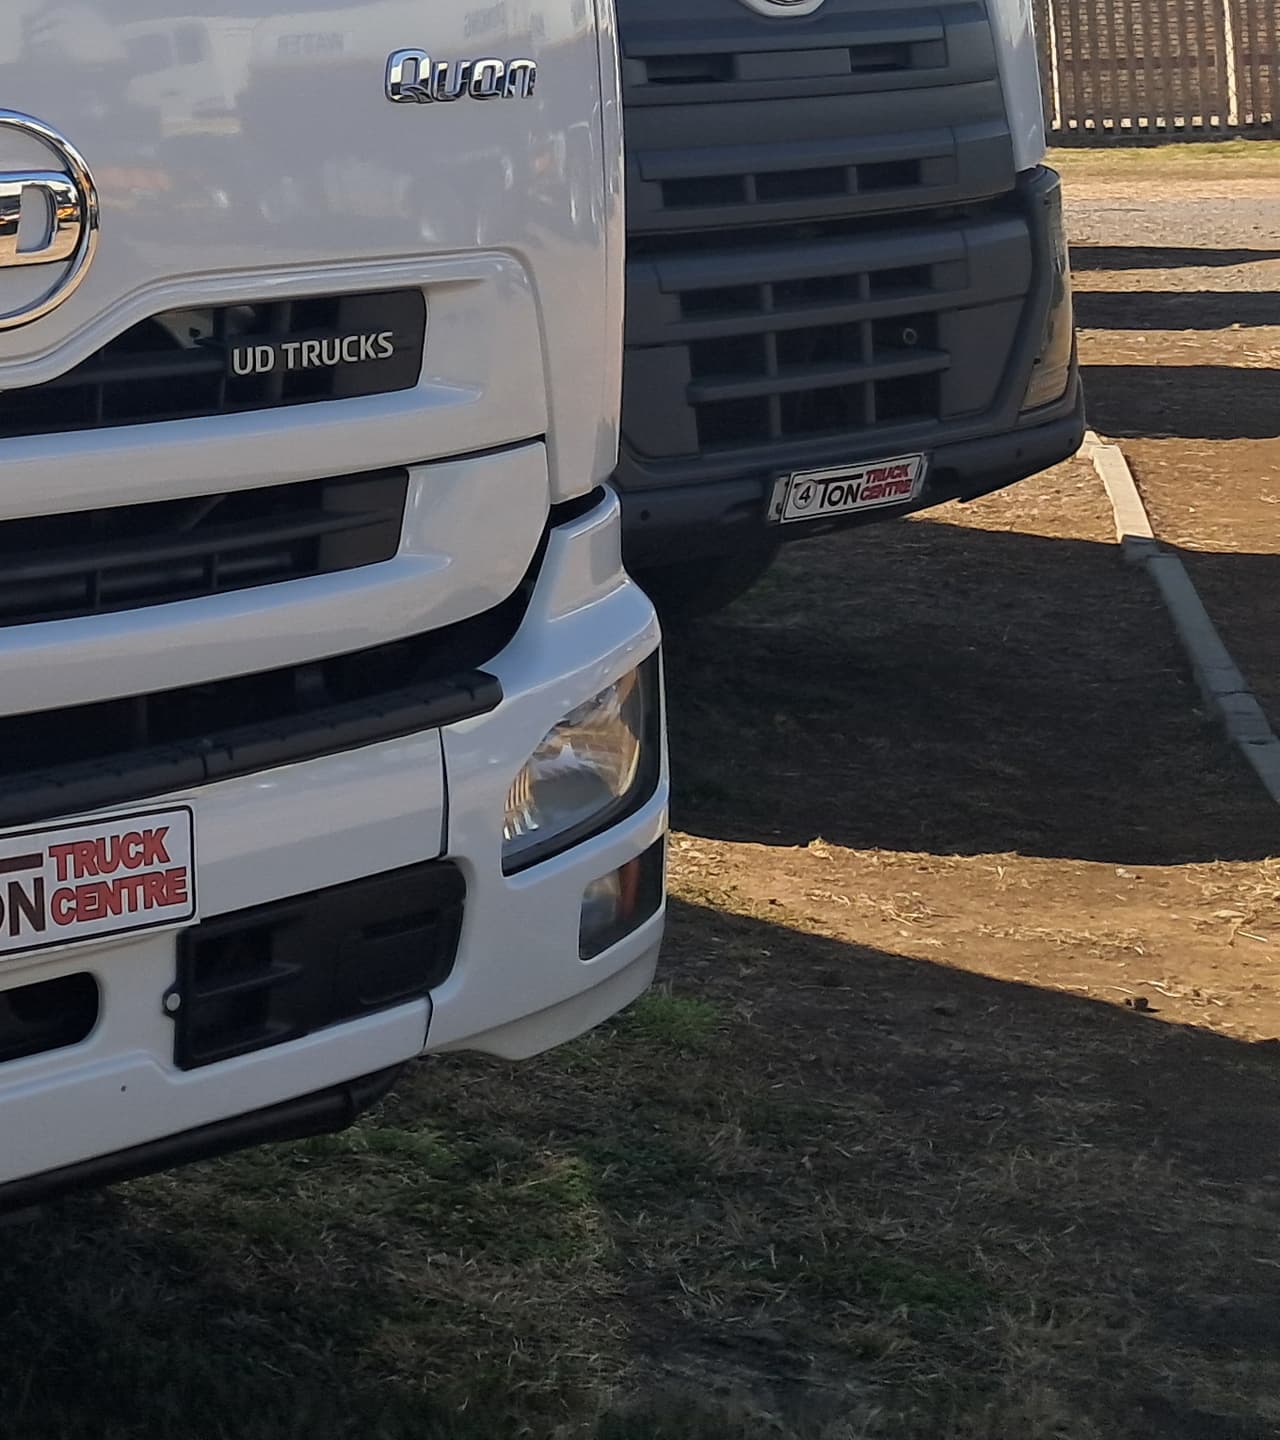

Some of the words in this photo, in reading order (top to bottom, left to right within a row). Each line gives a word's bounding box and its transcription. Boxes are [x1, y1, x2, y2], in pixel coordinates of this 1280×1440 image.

[385, 47, 538, 104] Quon
[232, 345, 276, 376] UD
[280, 331, 395, 365] TRUCKS
[797, 486, 811, 504] 4
[812, 474, 864, 509] TON
[860, 479, 913, 502] CENTRE
[865, 464, 911, 484] TRUCK
[48, 826, 170, 881] TRUCK
[50, 867, 188, 926] CENTRE
